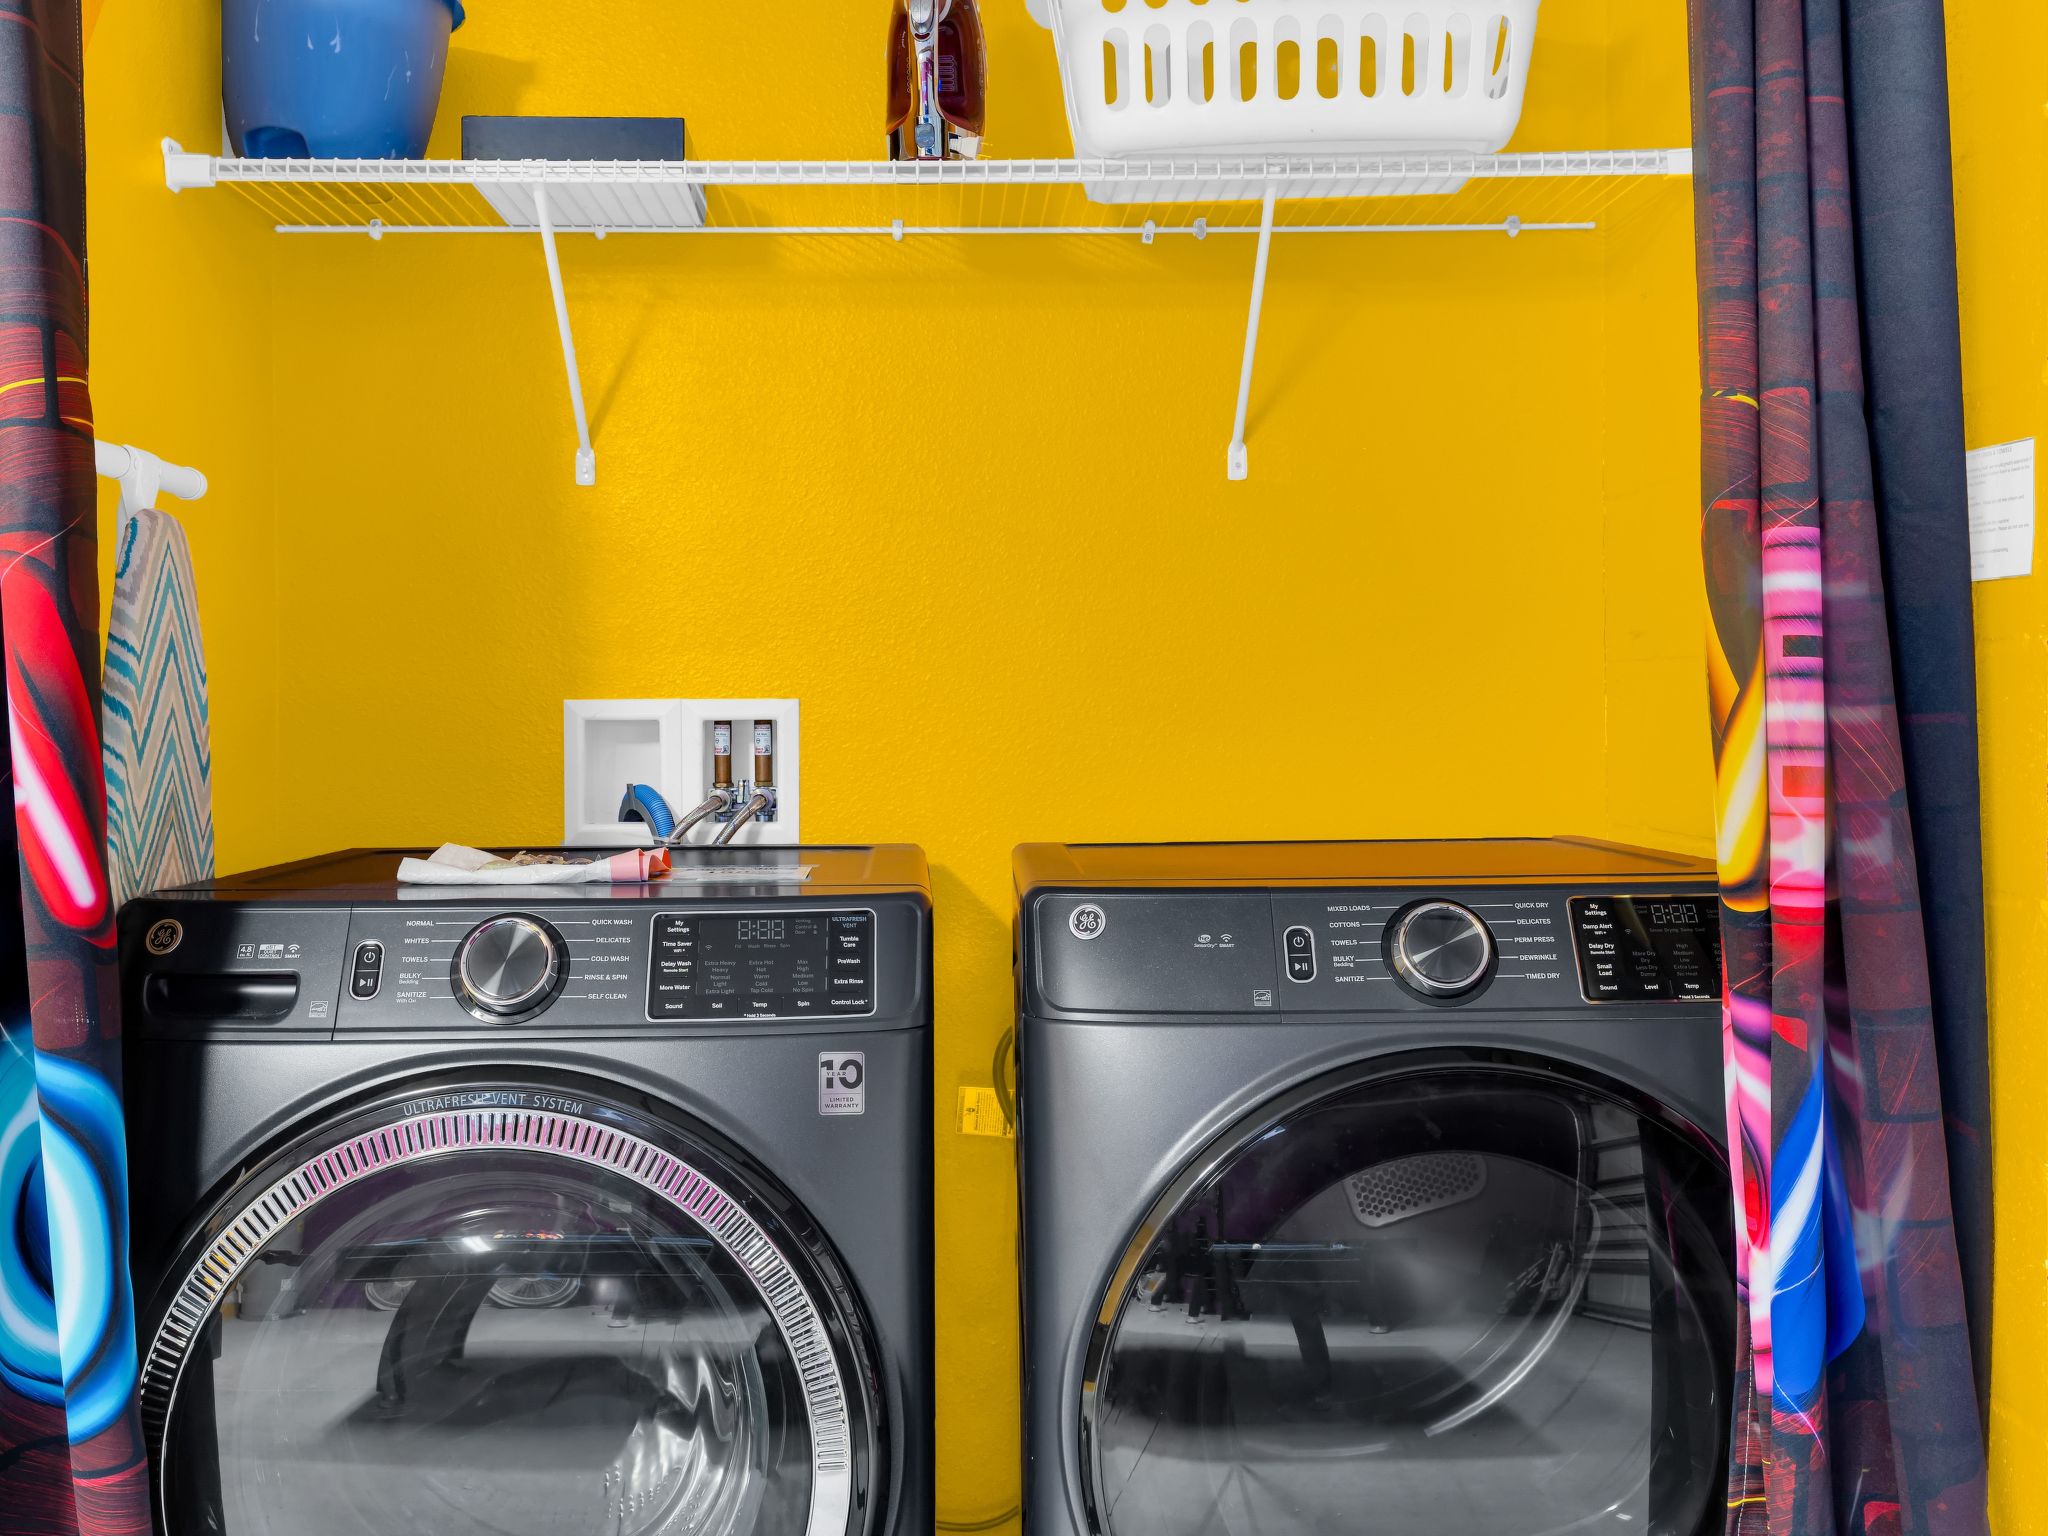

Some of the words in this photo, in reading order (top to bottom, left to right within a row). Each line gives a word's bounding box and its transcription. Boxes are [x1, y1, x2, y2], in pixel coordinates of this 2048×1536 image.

[820, 1059, 863, 1089] 10
[403, 1093, 486, 1116] ULTRAFRESH
[493, 1093, 526, 1106] VENT
[533, 1095, 582, 1114] SYSTEM
